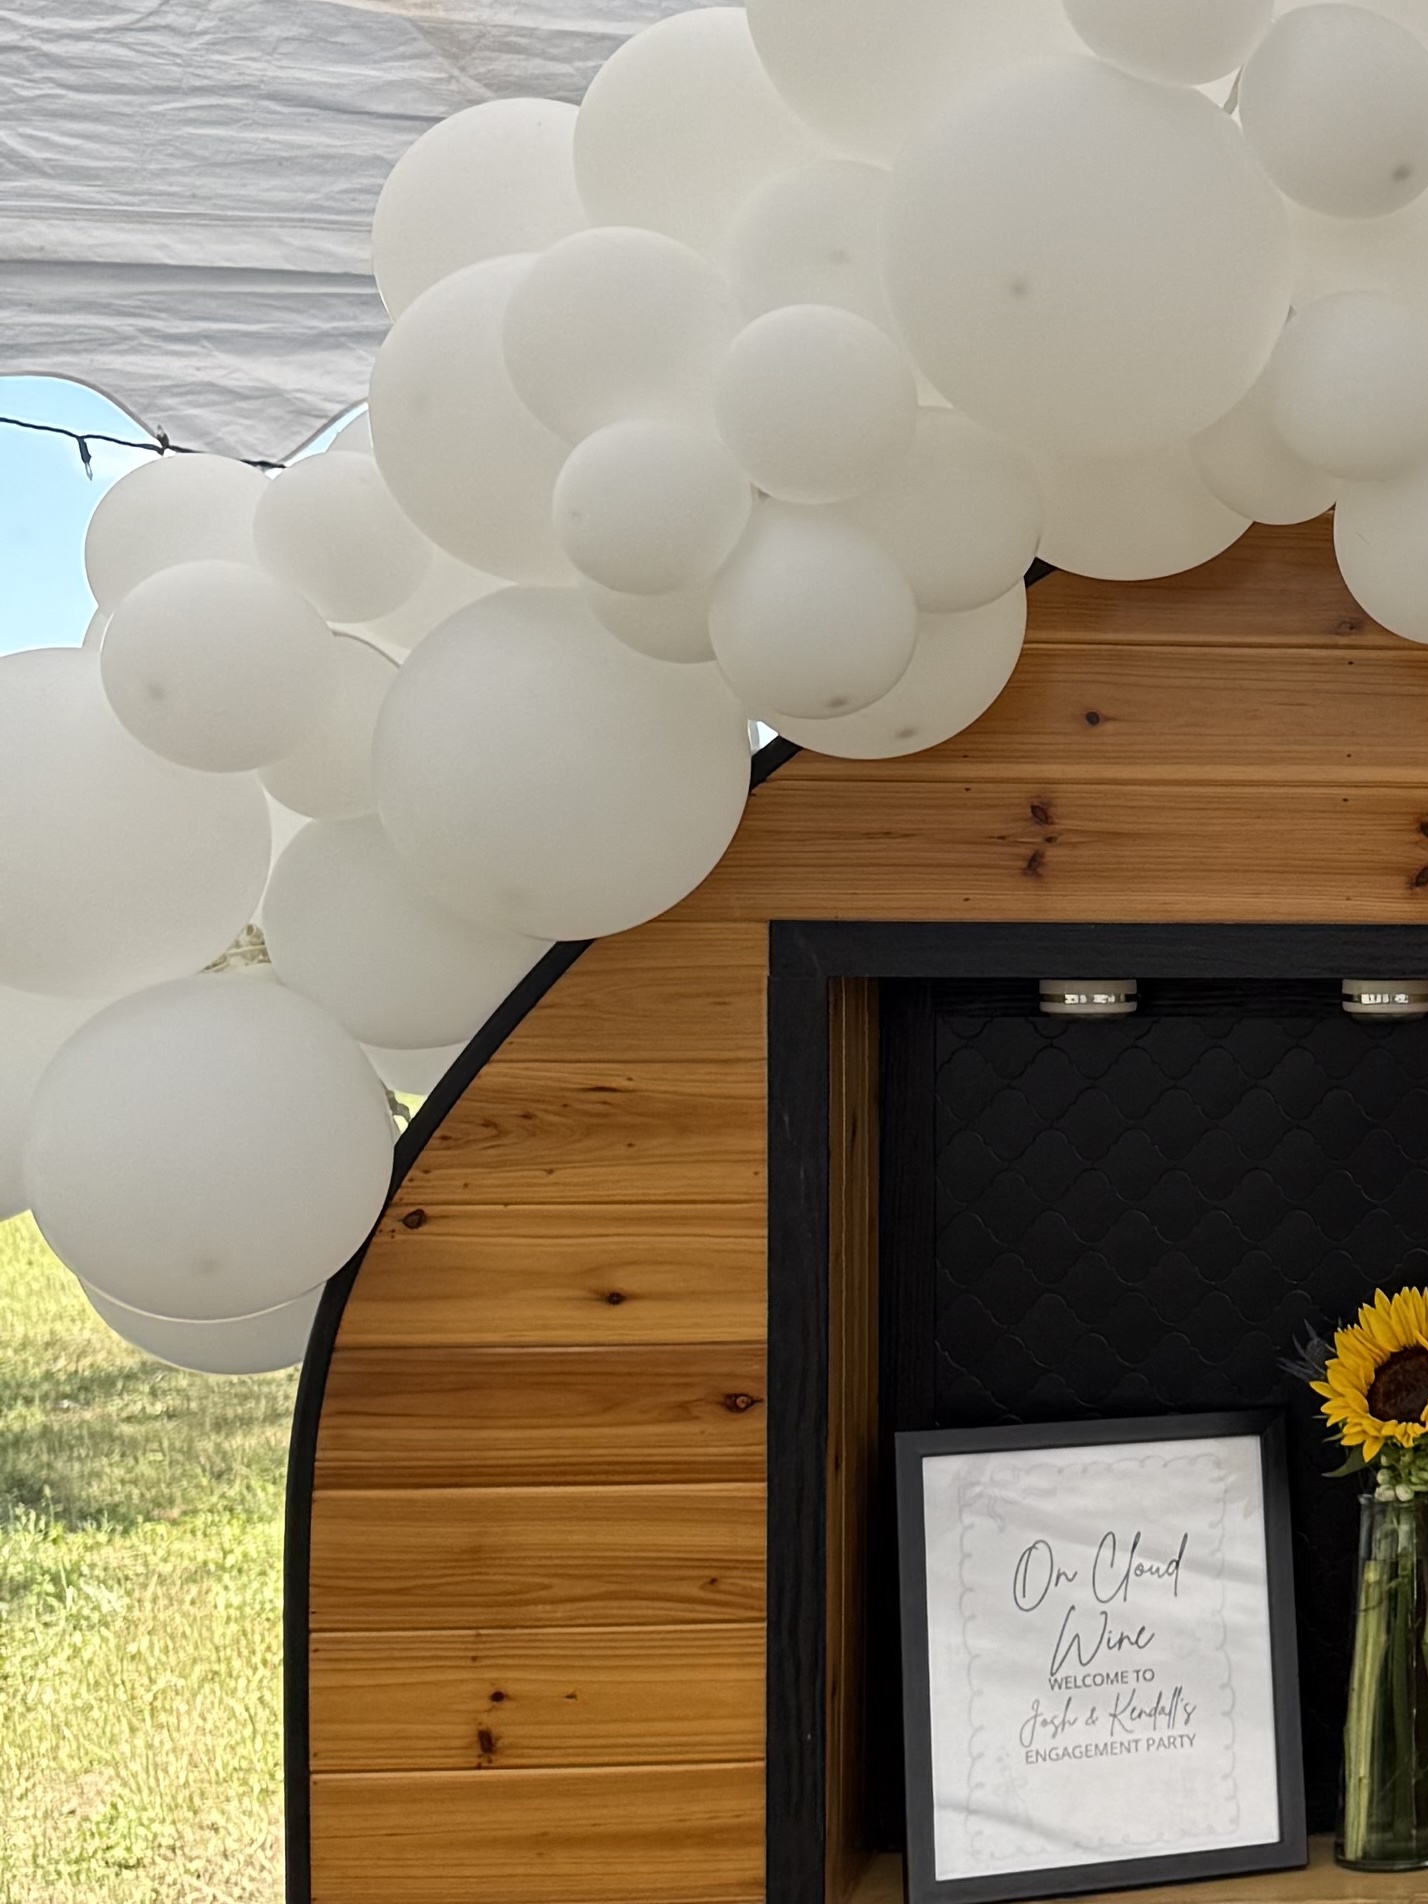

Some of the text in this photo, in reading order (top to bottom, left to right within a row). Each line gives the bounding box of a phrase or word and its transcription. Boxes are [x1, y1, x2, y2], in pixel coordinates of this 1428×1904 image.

[1013, 1531, 1188, 1612] On Cloud
[1050, 1605, 1155, 1676] Wine
[1048, 1668, 1155, 1691] WELCOME TO
[1019, 1686, 1197, 1747] Josh & Kendall's
[1025, 1733, 1196, 1764] ENGAGEMENT PARTY
